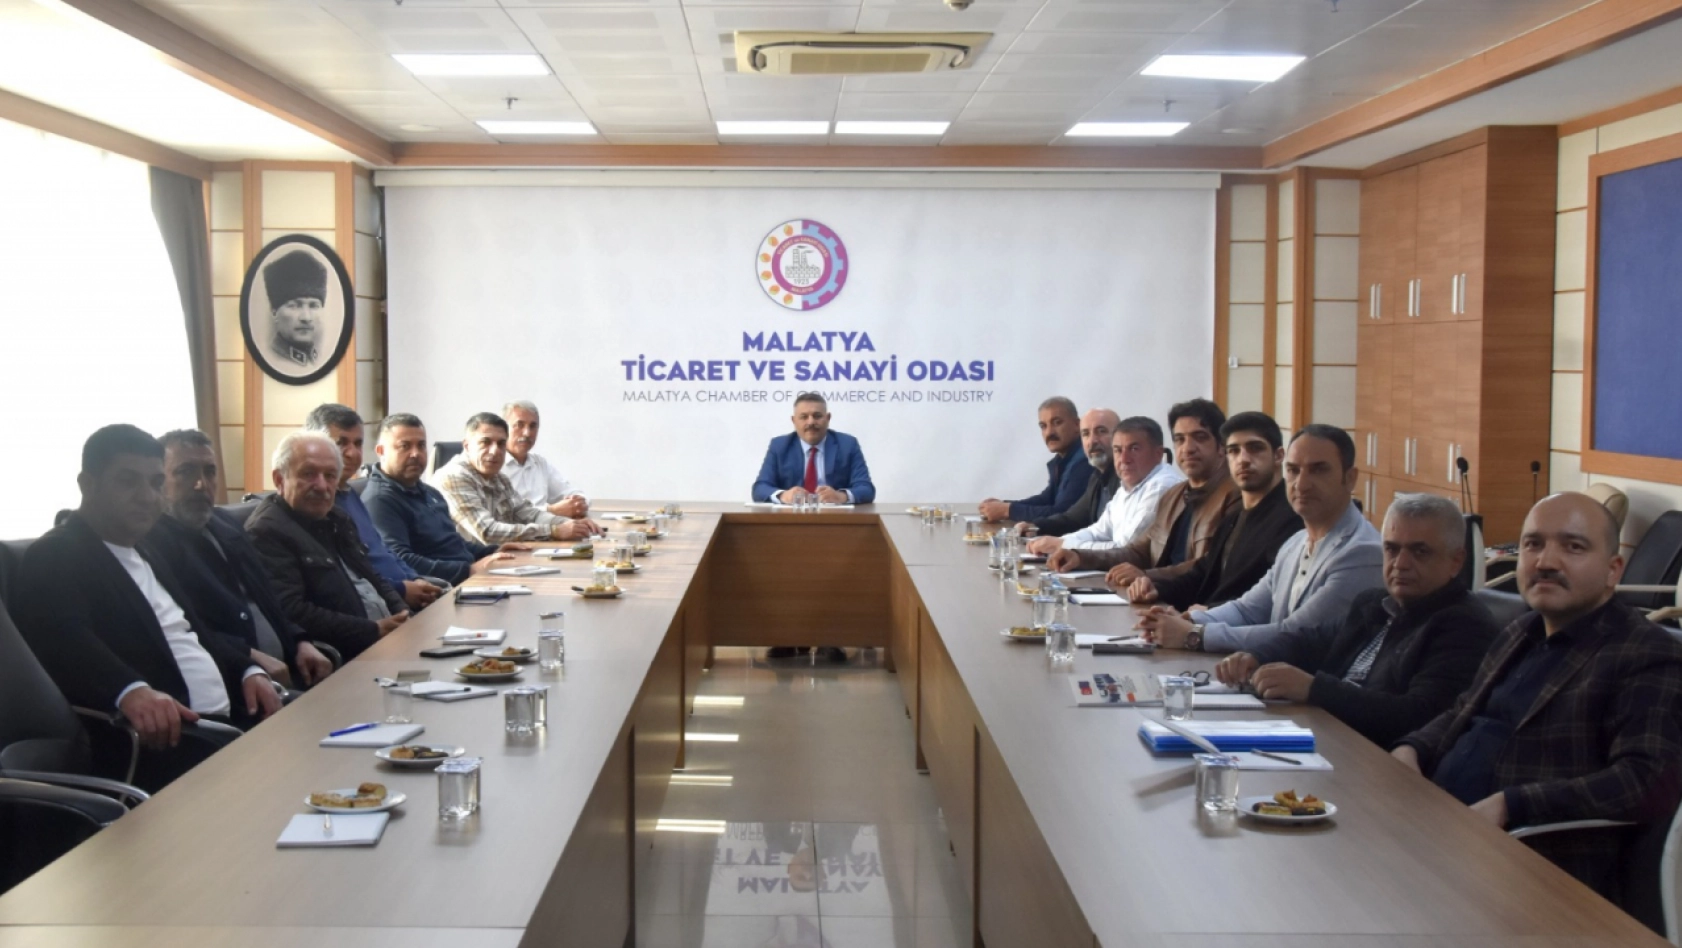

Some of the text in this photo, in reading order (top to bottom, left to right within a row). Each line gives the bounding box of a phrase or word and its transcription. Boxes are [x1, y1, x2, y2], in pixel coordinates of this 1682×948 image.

[743, 331, 875, 352] MALATYA
[621, 354, 994, 381] TİCARET VE SANAYİ ODASI
[623, 390, 691, 402] MALATYA
[696, 390, 768, 402] CHAMBER
[772, 390, 793, 402] OF
[890, 390, 922, 402] AND
[927, 390, 994, 402] INDUSTRY
